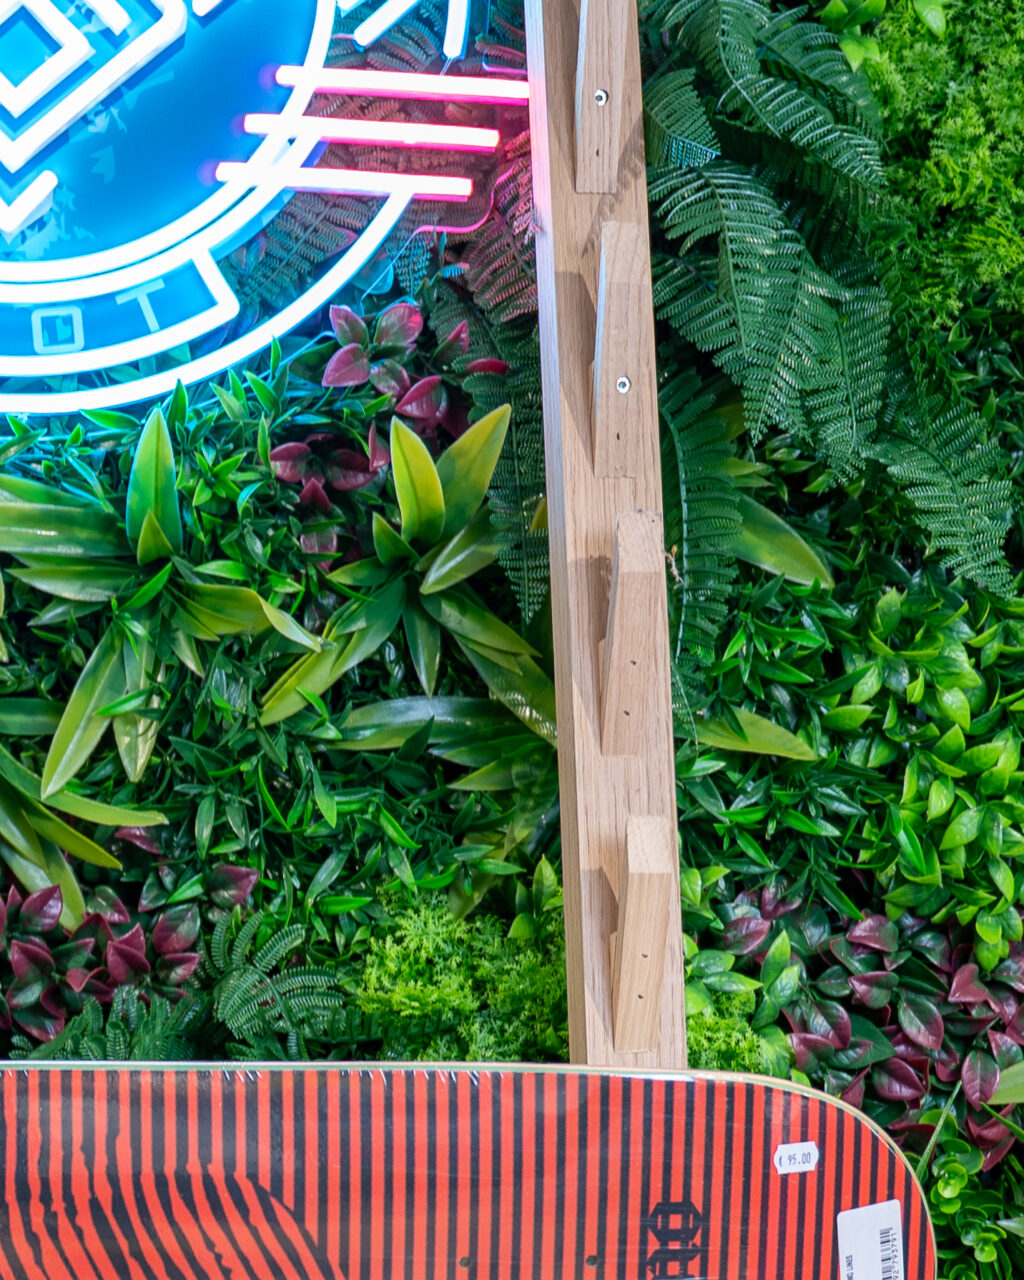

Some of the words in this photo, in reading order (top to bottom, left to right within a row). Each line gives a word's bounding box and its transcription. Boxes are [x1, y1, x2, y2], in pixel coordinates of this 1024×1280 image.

[787, 1152, 811, 1166] 95.00
[890, 1232, 899, 1265] 793791
[845, 1255, 853, 1271] LINES
